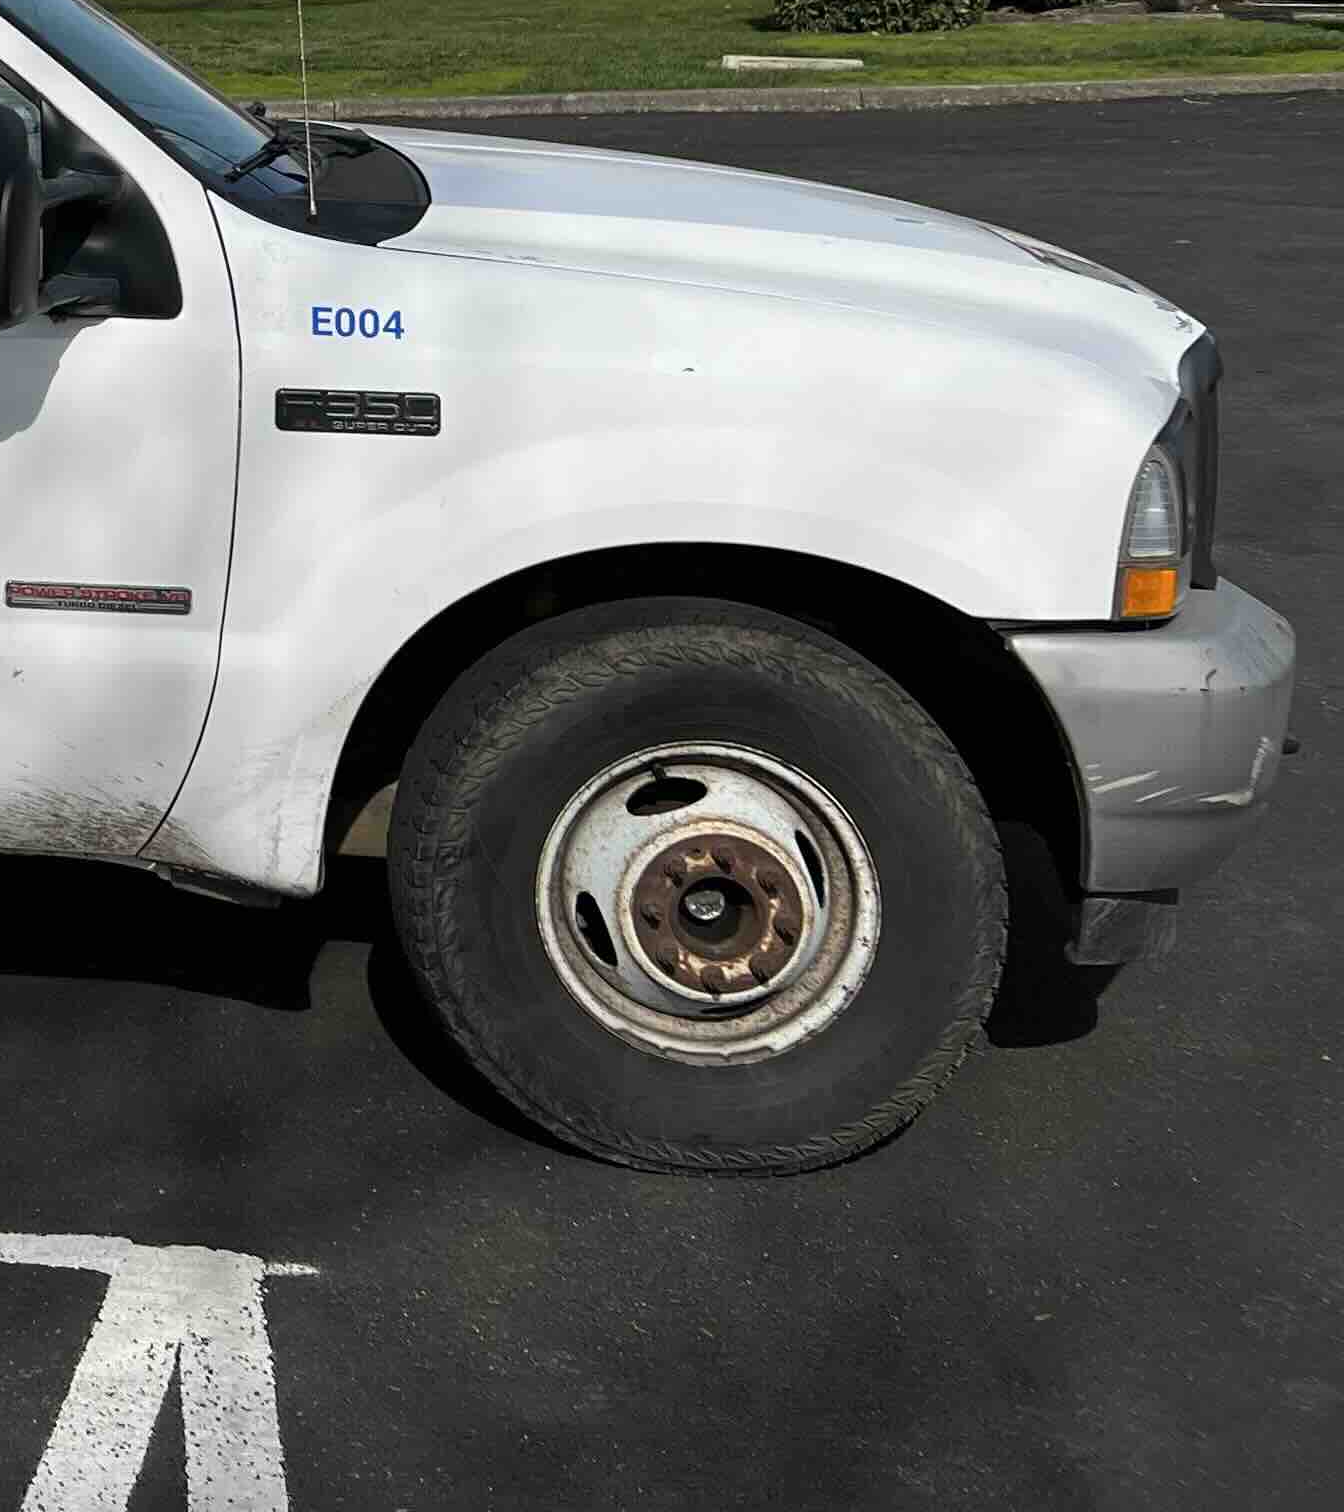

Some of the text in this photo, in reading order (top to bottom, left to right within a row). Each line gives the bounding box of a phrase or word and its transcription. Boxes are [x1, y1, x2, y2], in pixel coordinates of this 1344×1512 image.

[312, 306, 405, 340] E004
[279, 389, 439, 420] F350
[332, 419, 389, 431] SUPER
[392, 422, 439, 433] DUTY
